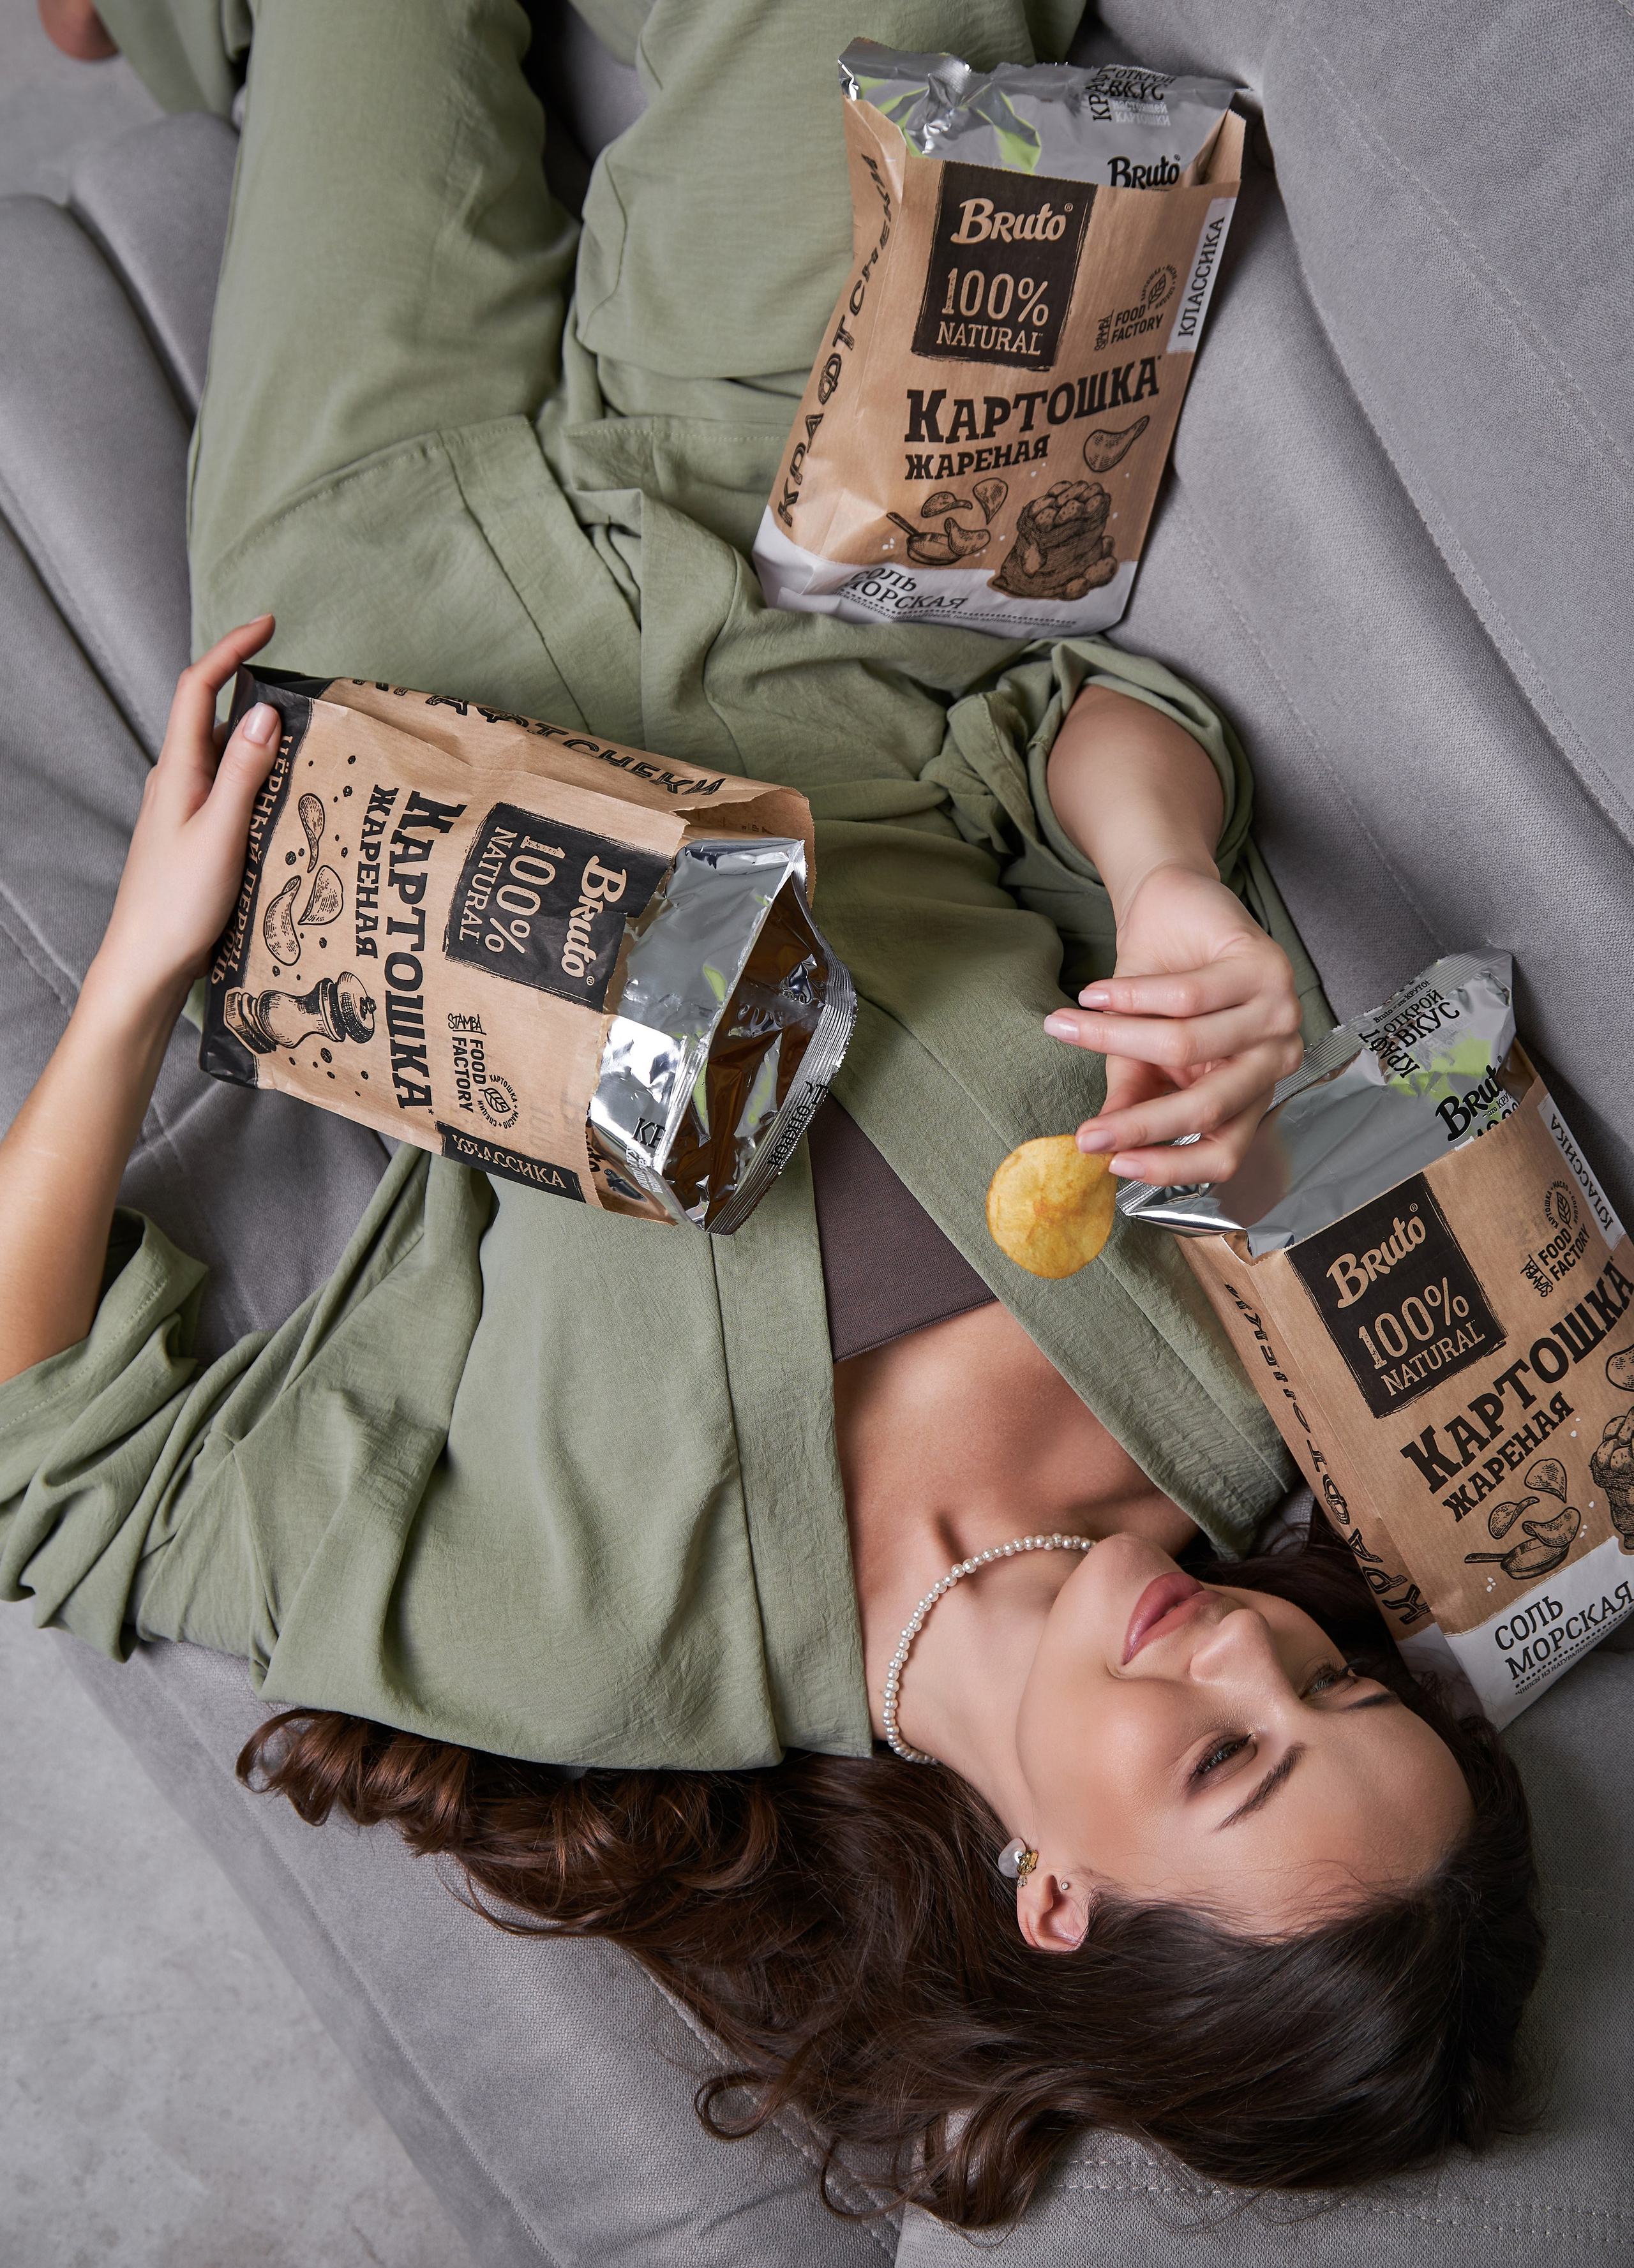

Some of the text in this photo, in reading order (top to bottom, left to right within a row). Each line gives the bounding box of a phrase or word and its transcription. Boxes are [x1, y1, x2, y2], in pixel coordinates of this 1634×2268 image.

[1109, 80, 1168, 100] ВКУС
[941, 267, 1049, 326] 100%
[1178, 216, 1225, 336] КЛАССИКА
[1111, 313, 1164, 344] FACTORY
[1115, 304, 1146, 327] FOOD
[904, 434, 1051, 480] ЖАРЕНАЯ
[850, 567, 917, 591] СОЛЬ
[356, 784, 400, 959] ЖАРЕНАЯ
[485, 834, 566, 954] 100%
[1373, 1008, 1393, 1024] Bruto
[1383, 990, 1444, 1033] ОТКРОЙ
[1393, 1001, 1460, 1048] ВКУС
[452, 1036, 474, 1113] FACTORY
[469, 1038, 486, 1085] FOOD
[1358, 1029, 1420, 1078] КРАФТ
[489, 1075, 518, 1103] КАРТОШКА
[477, 1100, 497, 1128] СПЕЦИИ
[503, 1110, 520, 1130] МАСЛО
[451, 1133, 567, 1189] КЛАССИКА
[1550, 1114, 1614, 1231] КЛАССИКА
[1545, 1191, 1559, 1230] КАРТОШКА
[1538, 1228, 1572, 1267] FOOD
[1548, 1223, 1590, 1281] FACTORY
[1358, 1277, 1469, 1369] 100%
[1442, 1391, 1575, 1523] ЖАРЕНАЯ
[1494, 1595, 1563, 1650] СОЛЬ
[1504, 1581, 1634, 1681] МОРСКАЯ
